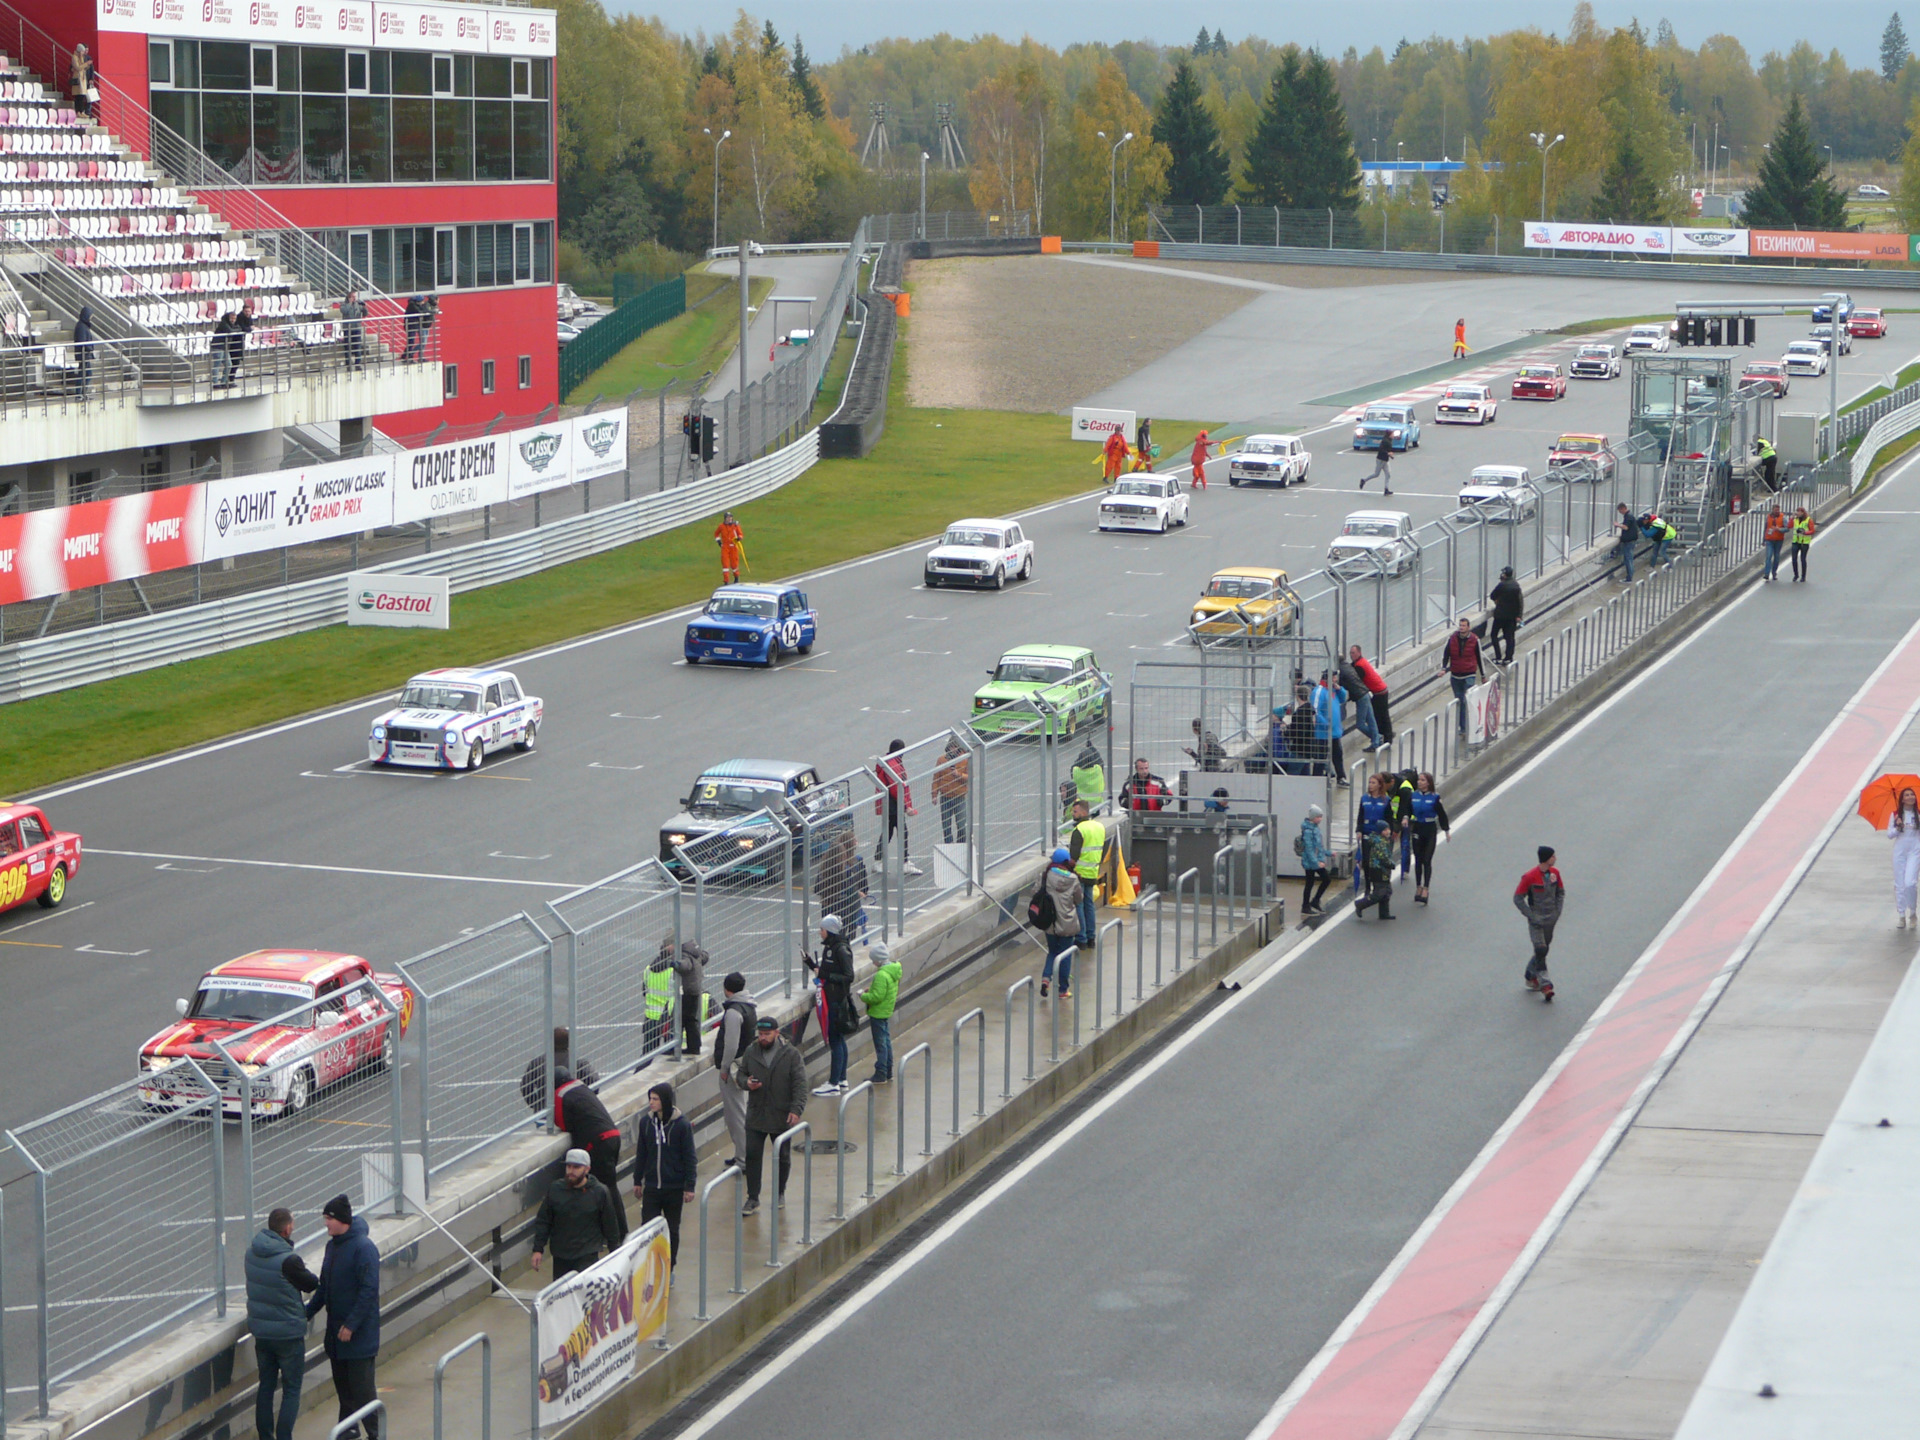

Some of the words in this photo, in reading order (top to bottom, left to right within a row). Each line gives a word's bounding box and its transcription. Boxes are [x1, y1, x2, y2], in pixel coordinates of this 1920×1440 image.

[165, 4, 185, 12] РАЗВИТИЕ
[165, 12, 183, 21] СТОЛИЦА
[214, 7, 233, 16] РАЗВИТИЕ
[214, 15, 231, 24] СТОЛИЦА
[1559, 231, 1635, 245] АВТОРАДИО
[1693, 234, 1726, 242] CLASSIC
[1756, 235, 1815, 253] ТЕХИНКОМ
[1875, 246, 1901, 254] LADA
[590, 424, 615, 447] CLASSIC
[527, 438, 555, 461] CLASSIC
[412, 449, 456, 490] СТАРОЕ
[459, 441, 496, 481] ВРЕМЯ
[313, 477, 354, 500] MOSCOW
[354, 471, 386, 492] CLASSIC
[234, 490, 277, 525] ЮНИТ
[430, 487, 477, 511] OLD-TIME.RU
[310, 501, 341, 522] GRAND
[343, 497, 363, 516] PRIX
[146, 517, 180, 544] МАТЧ!
[63, 533, 99, 561] МАТЧ!
[376, 593, 432, 612] Castrol
[784, 623, 798, 644] 14
[703, 782, 718, 799] 5
